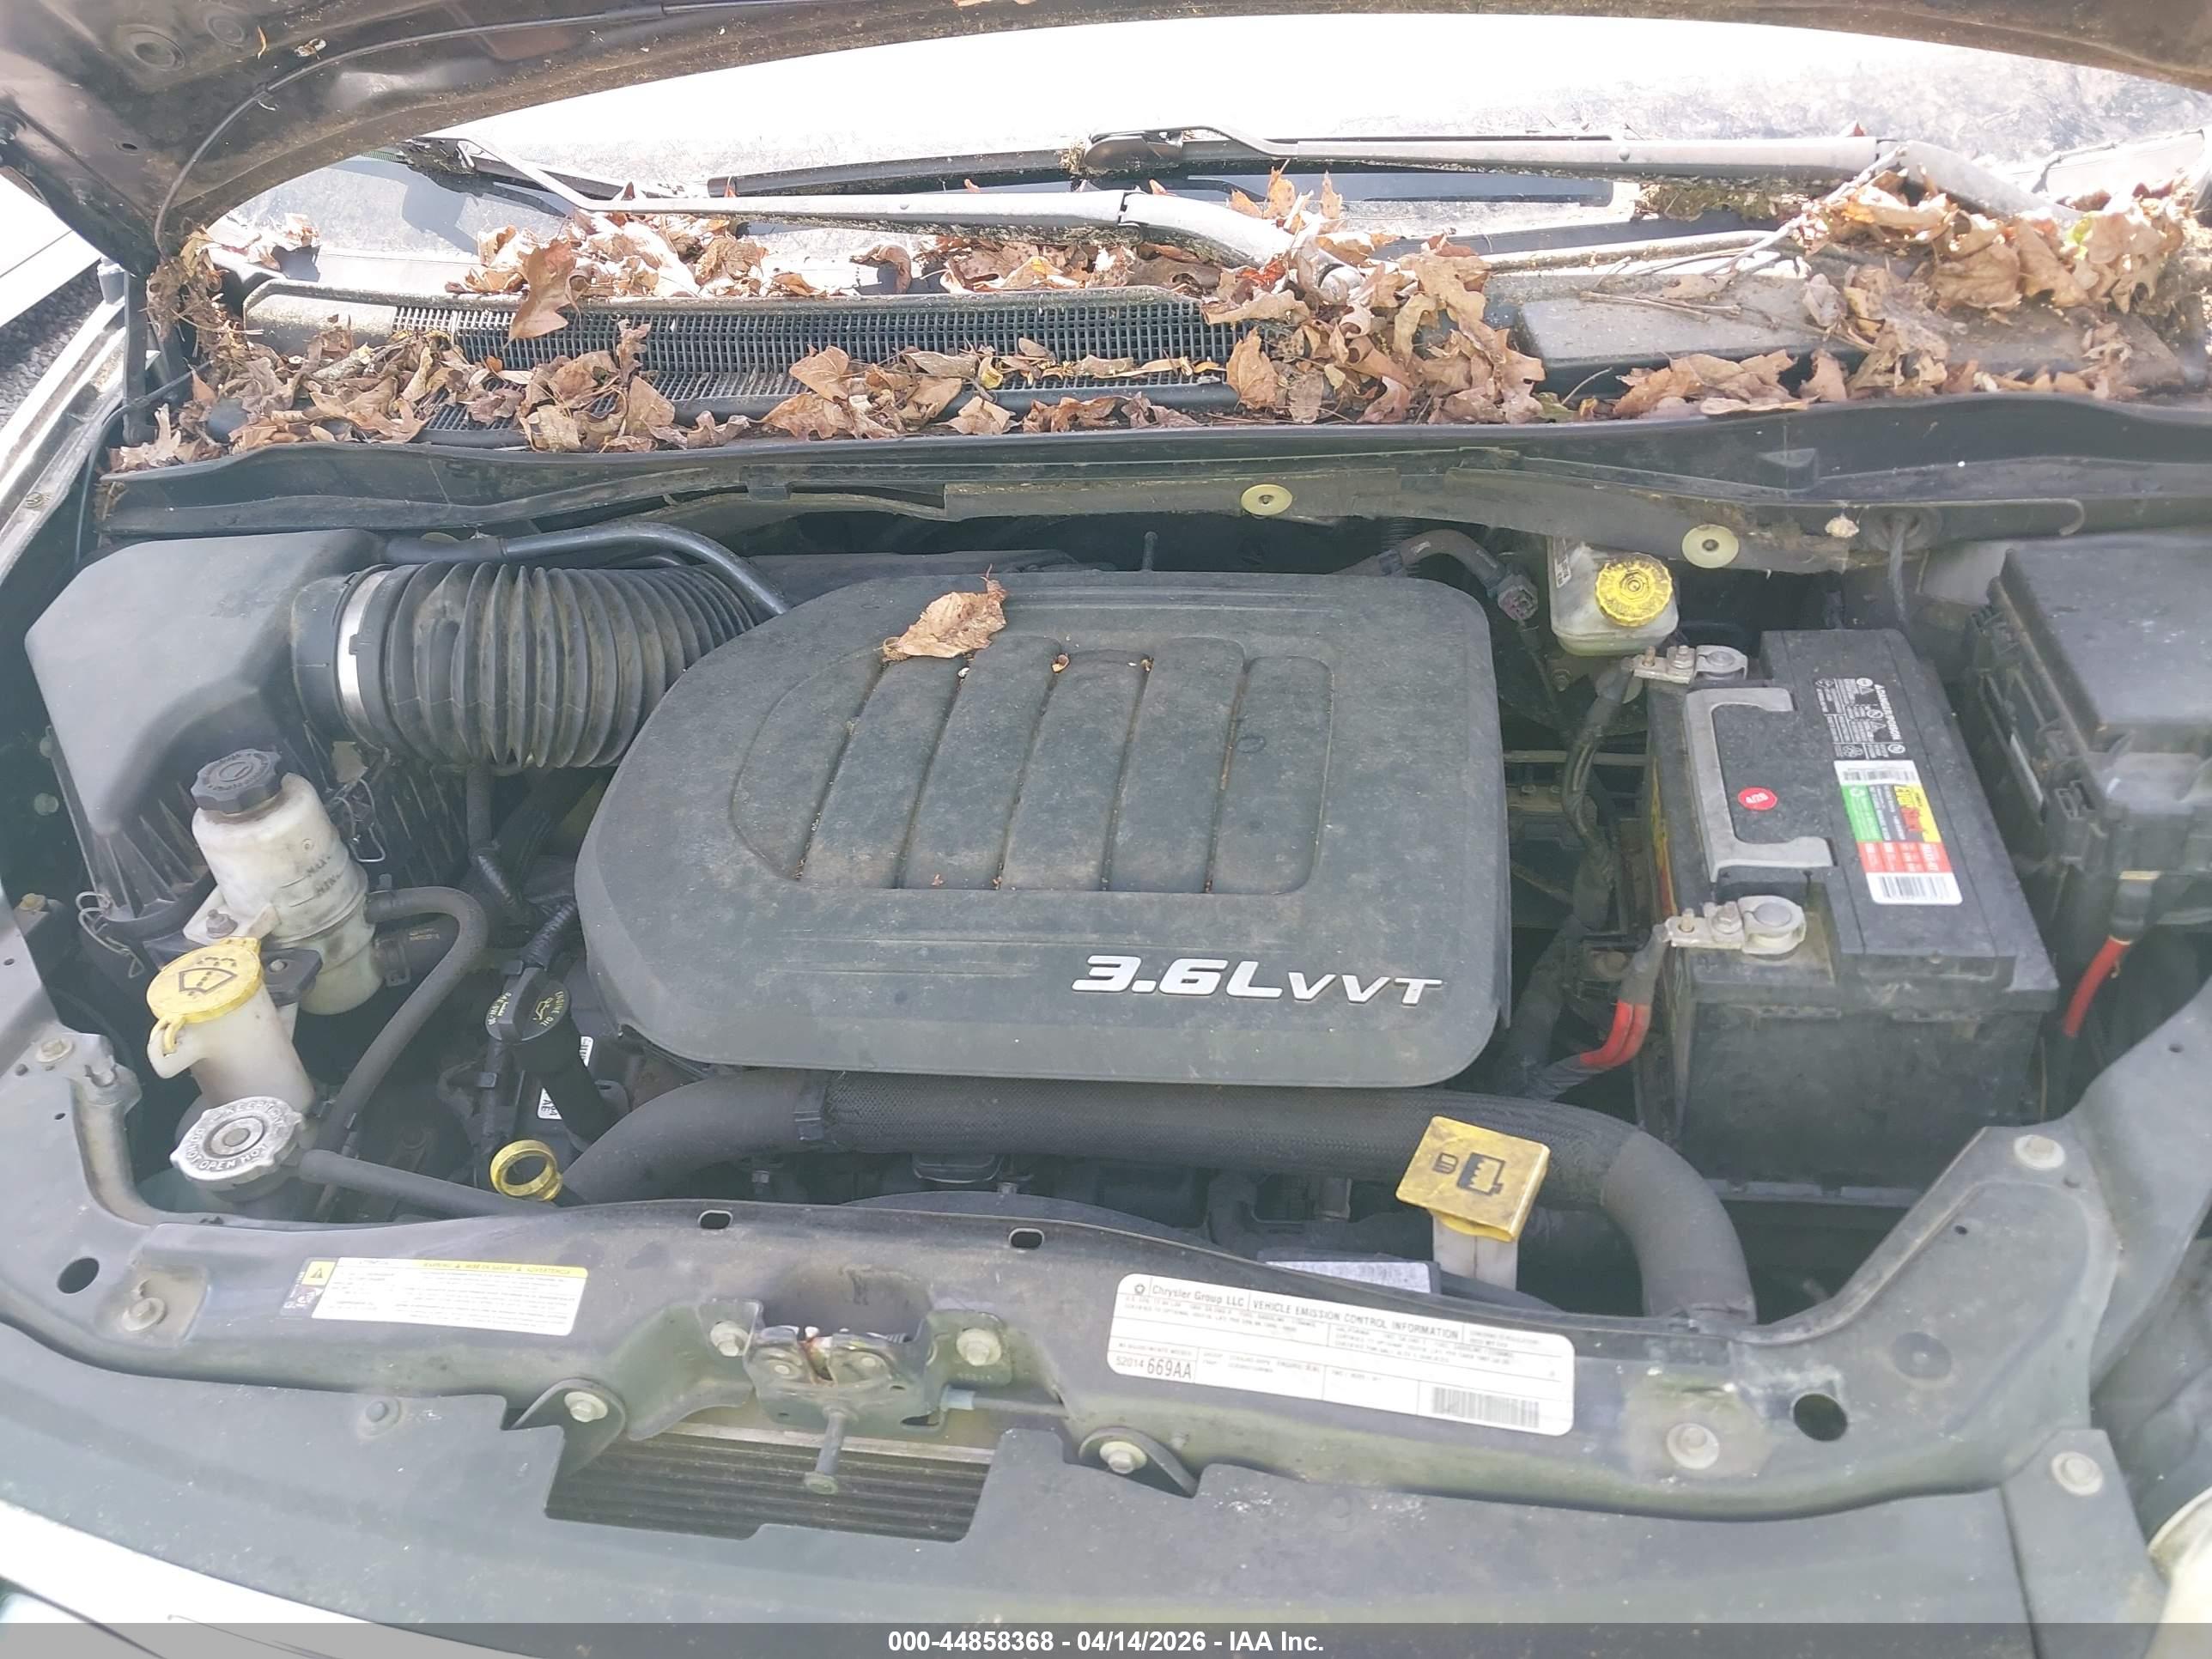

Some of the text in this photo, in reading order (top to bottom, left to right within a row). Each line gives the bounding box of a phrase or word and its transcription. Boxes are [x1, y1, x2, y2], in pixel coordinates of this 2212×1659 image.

[539, 1016, 554, 1027] OIL
[198, 1159, 236, 1170] OPEN
[240, 1144, 268, 1163] HOT
[1152, 1285, 1191, 1300] Chrysler
[1194, 1291, 1223, 1304] Group
[1226, 1295, 1244, 1306] LLC
[1253, 1299, 1292, 1314] VEHICLE
[1296, 1305, 1340, 1322] EMISSION
[1344, 1314, 1388, 1329] CONTROL
[1391, 1322, 1458, 1340] INFORMATION
[1146, 1358, 1192, 1379] 669AA
